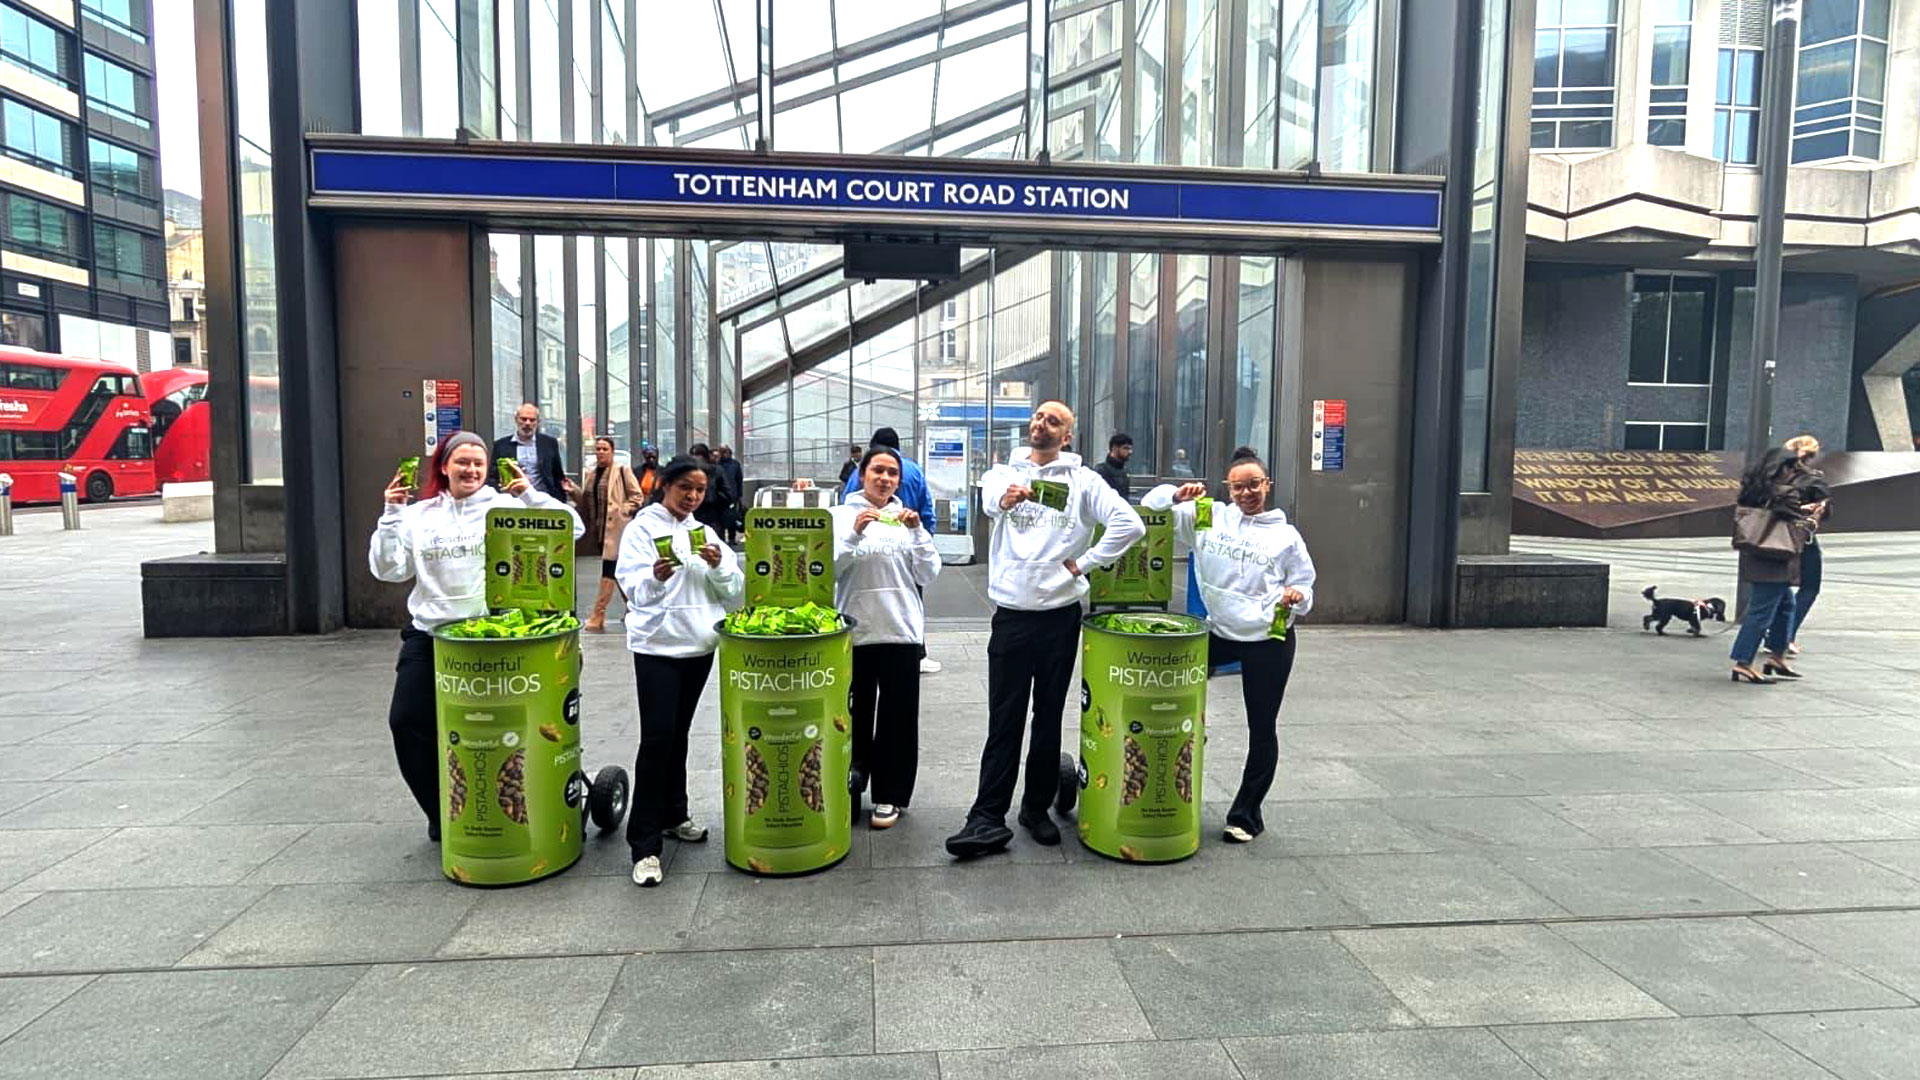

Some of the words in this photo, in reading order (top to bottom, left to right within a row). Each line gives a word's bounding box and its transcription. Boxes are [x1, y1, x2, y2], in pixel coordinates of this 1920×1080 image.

[673, 172, 837, 200] TOTTENHAM
[846, 179, 935, 203] COURT
[943, 183, 1016, 206] ROAD
[1023, 185, 1130, 210] STATION
[1600, 451, 1645, 462] YOU
[1549, 464, 1654, 475] REFLECTED
[1514, 477, 1616, 489] WINDOW
[1619, 477, 1649, 489] OF
[1654, 478, 1676, 489] A
[1534, 491, 1557, 502] IT
[1557, 491, 1582, 502] IS
[1584, 491, 1622, 502] AN
[1621, 491, 1697, 502] ANGEL
[494, 516, 515, 529] NO
[518, 517, 567, 531] SHELLS
[754, 517, 775, 529] NO
[778, 517, 826, 530] SHELLS
[443, 655, 522, 673] Wonderful
[743, 652, 821, 669] Wonderful
[1127, 651, 1198, 666] Wonderful
[729, 667, 836, 692] PISTACHIOS
[1108, 664, 1205, 688] PISTACHIOS
[435, 671, 542, 697] PISTACHIOS
